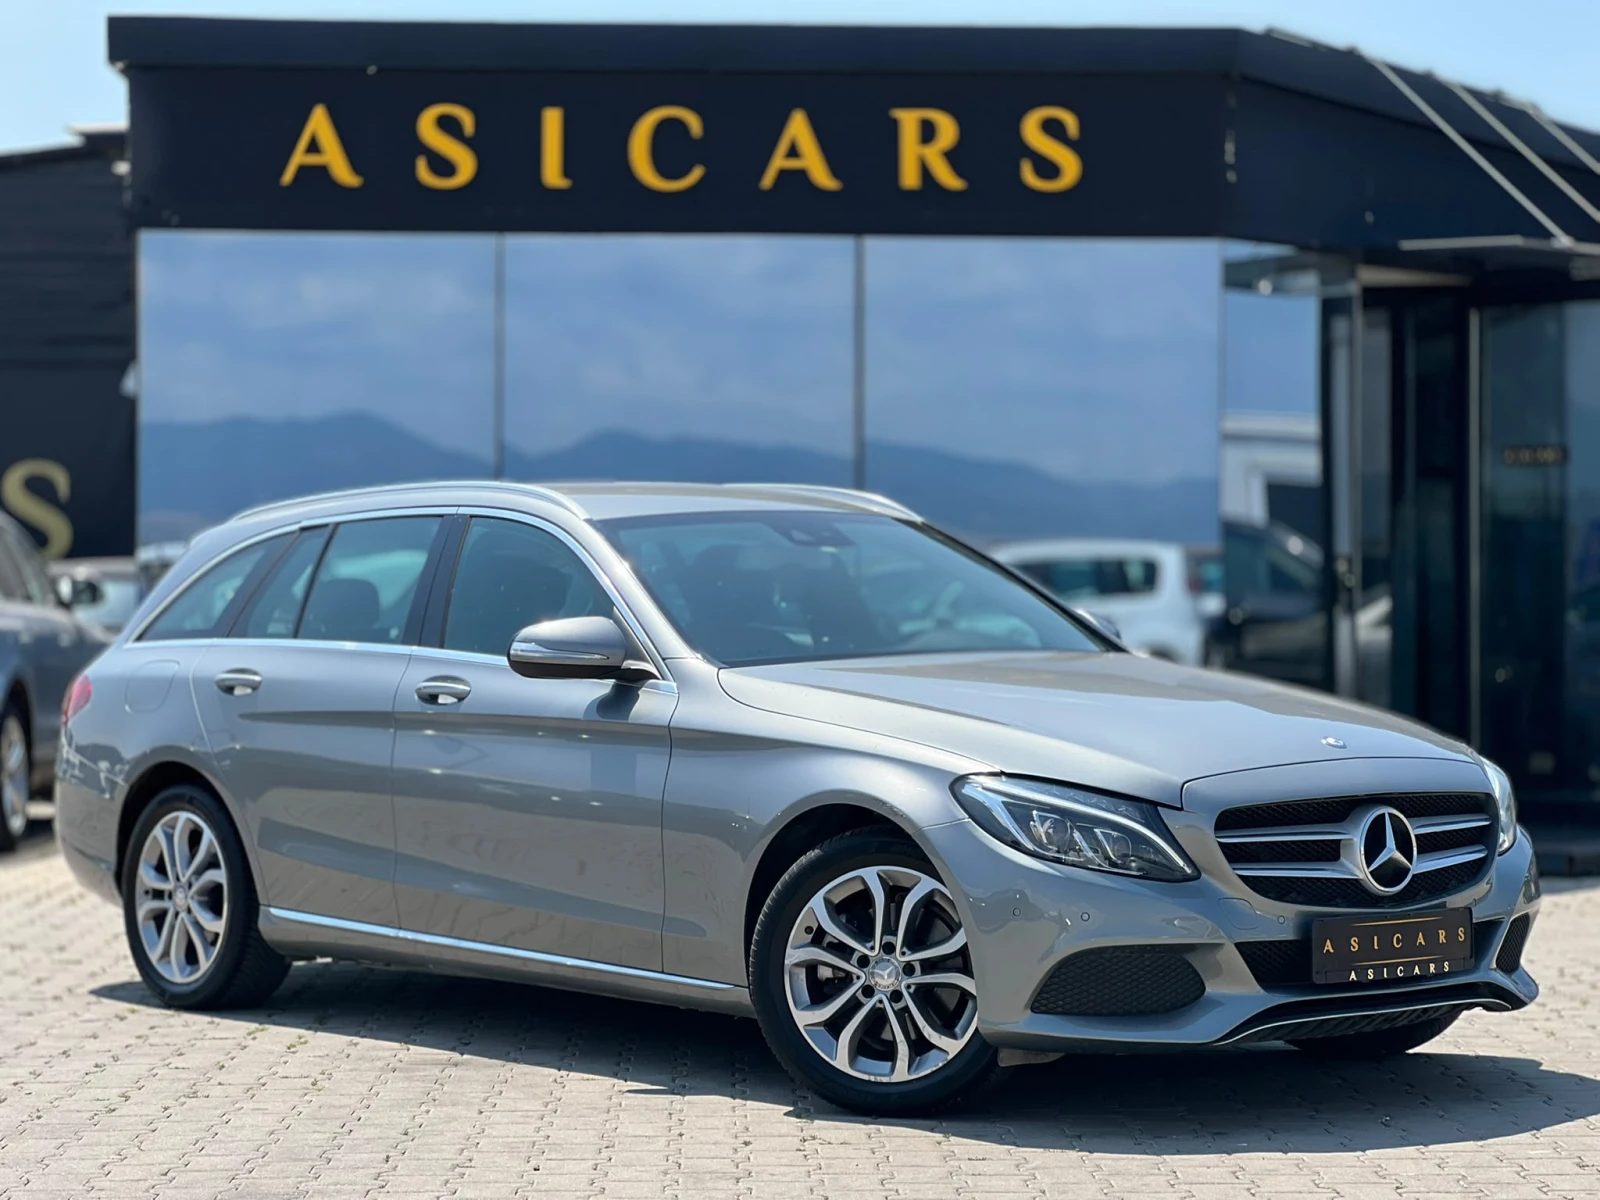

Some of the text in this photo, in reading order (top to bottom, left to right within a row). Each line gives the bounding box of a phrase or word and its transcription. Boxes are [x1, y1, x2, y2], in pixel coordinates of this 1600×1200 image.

[281, 103, 1083, 192] ASICARS
[1323, 927, 1465, 954] ASICARS
[1349, 961, 1449, 981] ASICARS
